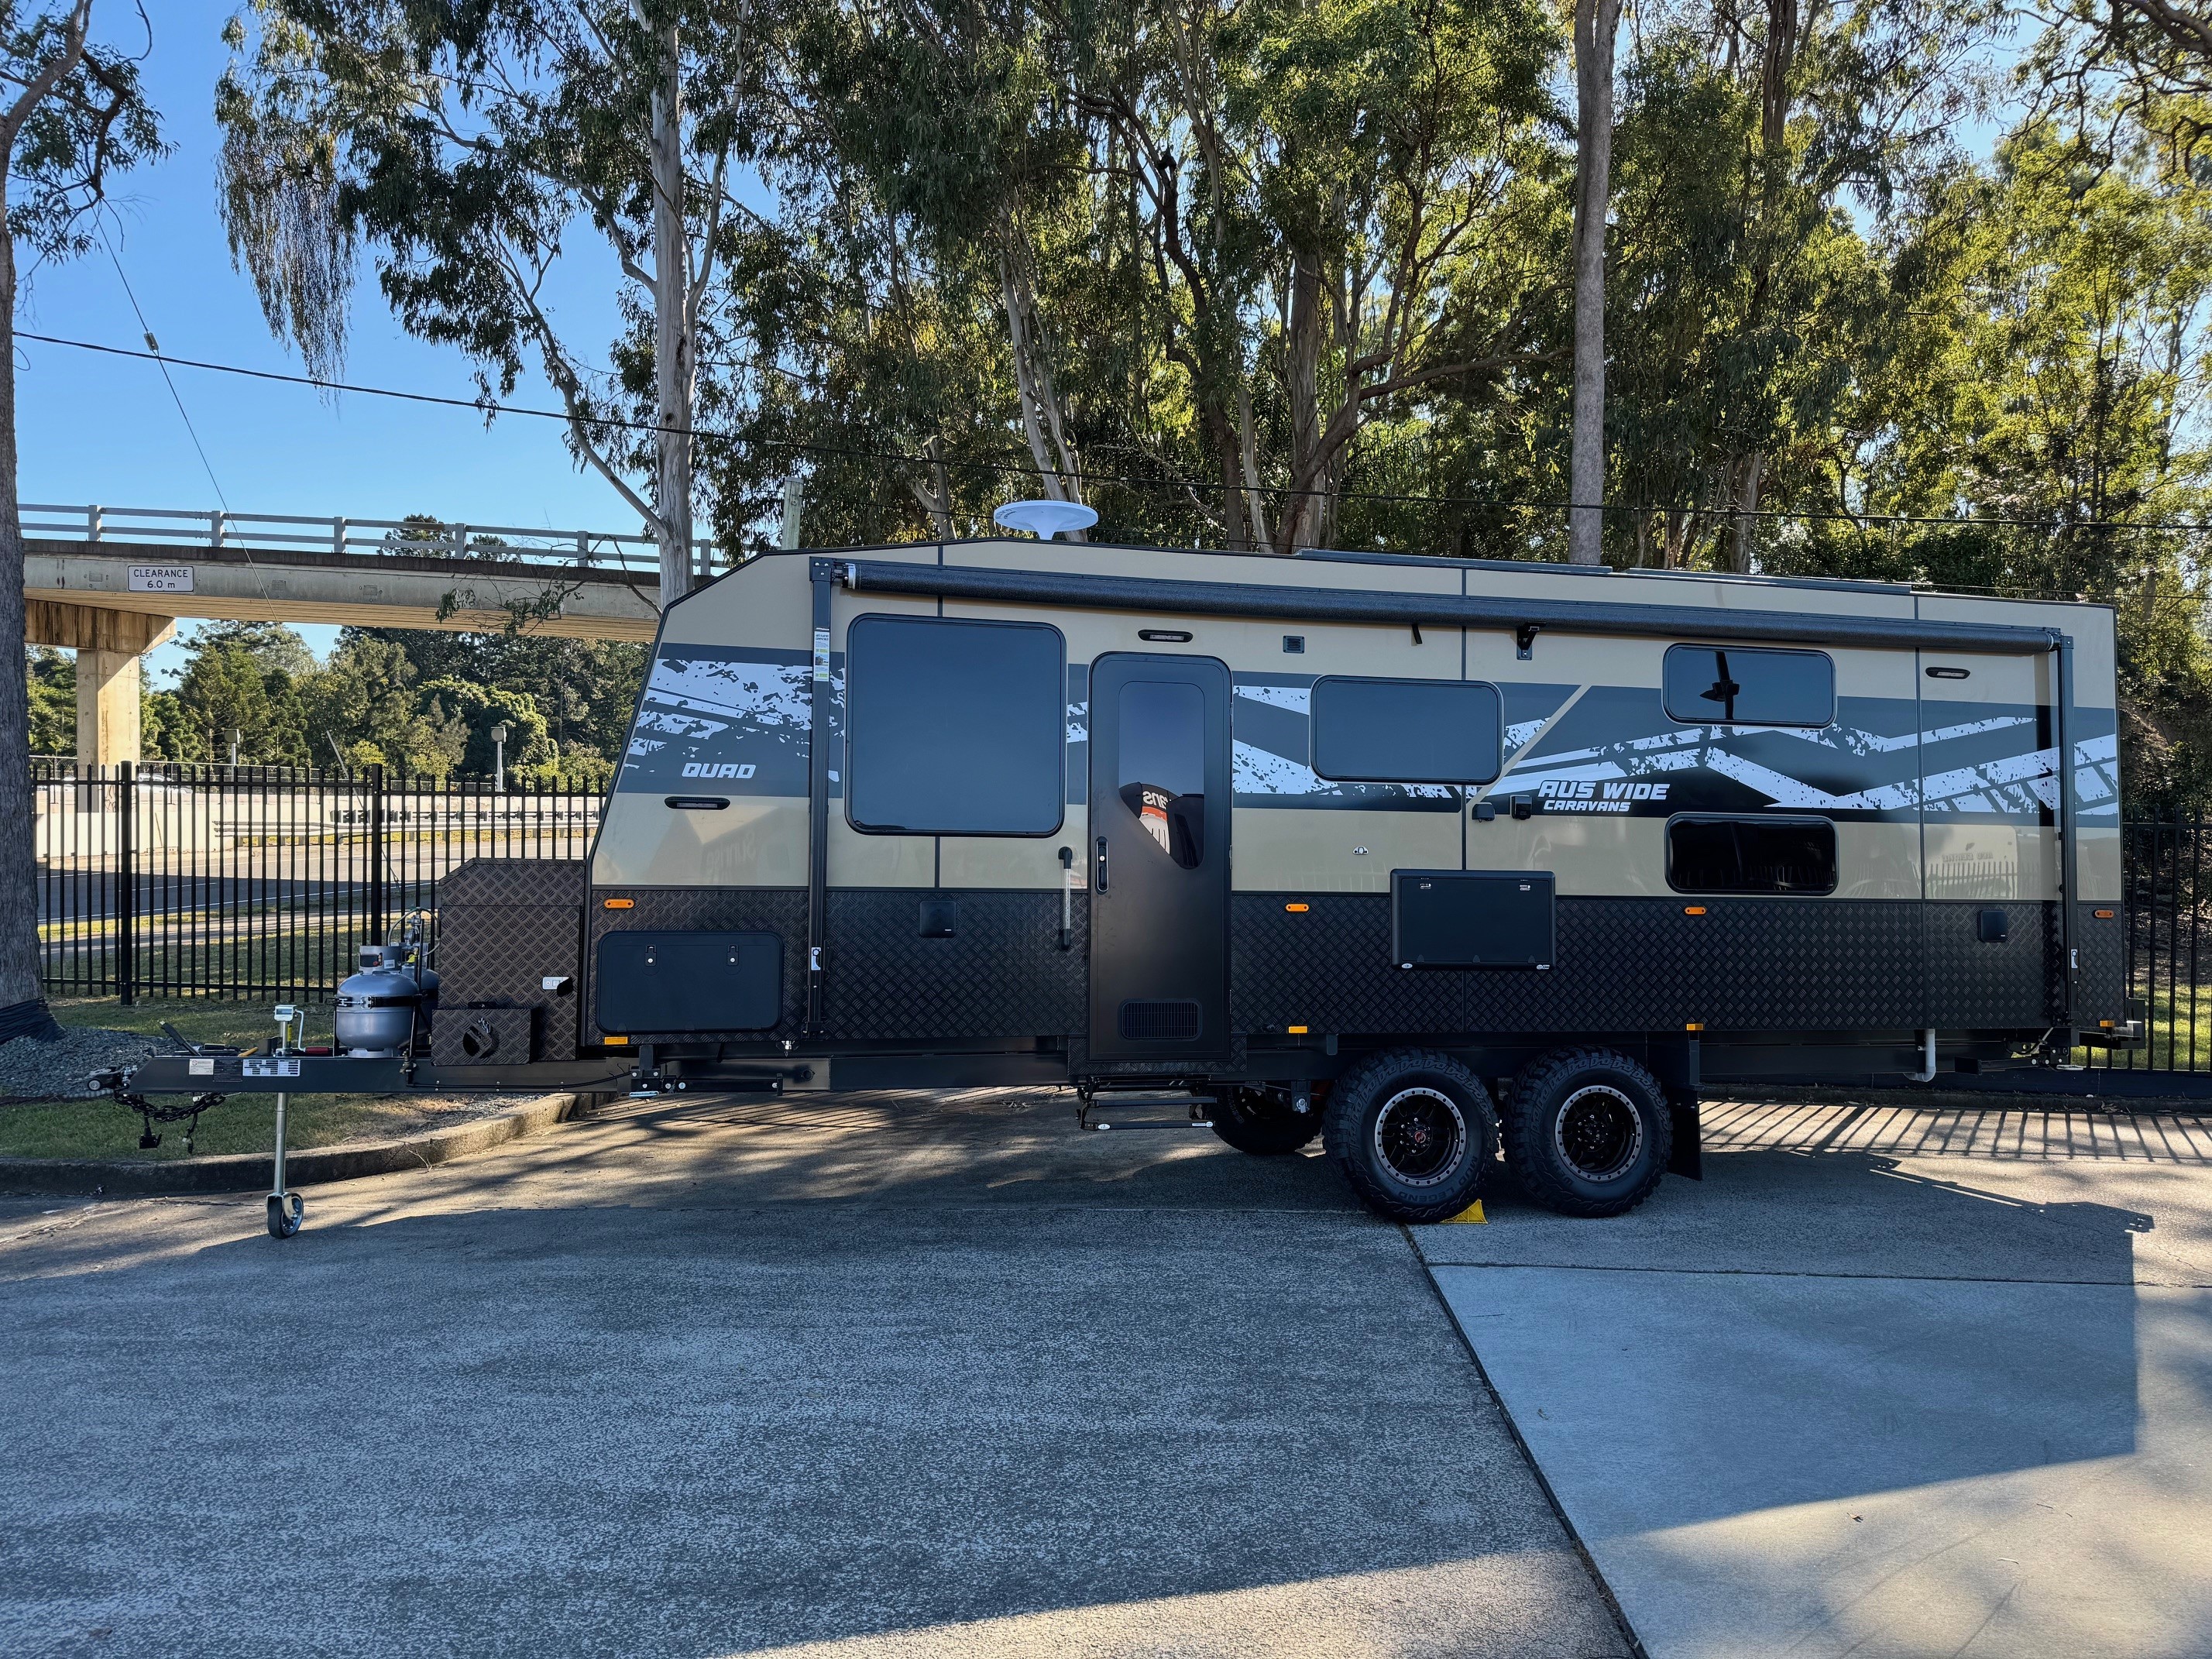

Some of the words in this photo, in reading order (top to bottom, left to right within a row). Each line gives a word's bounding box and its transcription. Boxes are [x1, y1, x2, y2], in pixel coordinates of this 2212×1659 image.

[134, 569, 188, 578] CLEARANCE
[682, 763, 756, 778] QUAD
[1538, 781, 1596, 799] AUS
[1602, 782, 1670, 800] WIDE
[1544, 800, 1631, 812] CARAVANS
[1458, 1155, 1479, 1187] MUD
[1398, 1186, 1455, 1203] LEGEND
